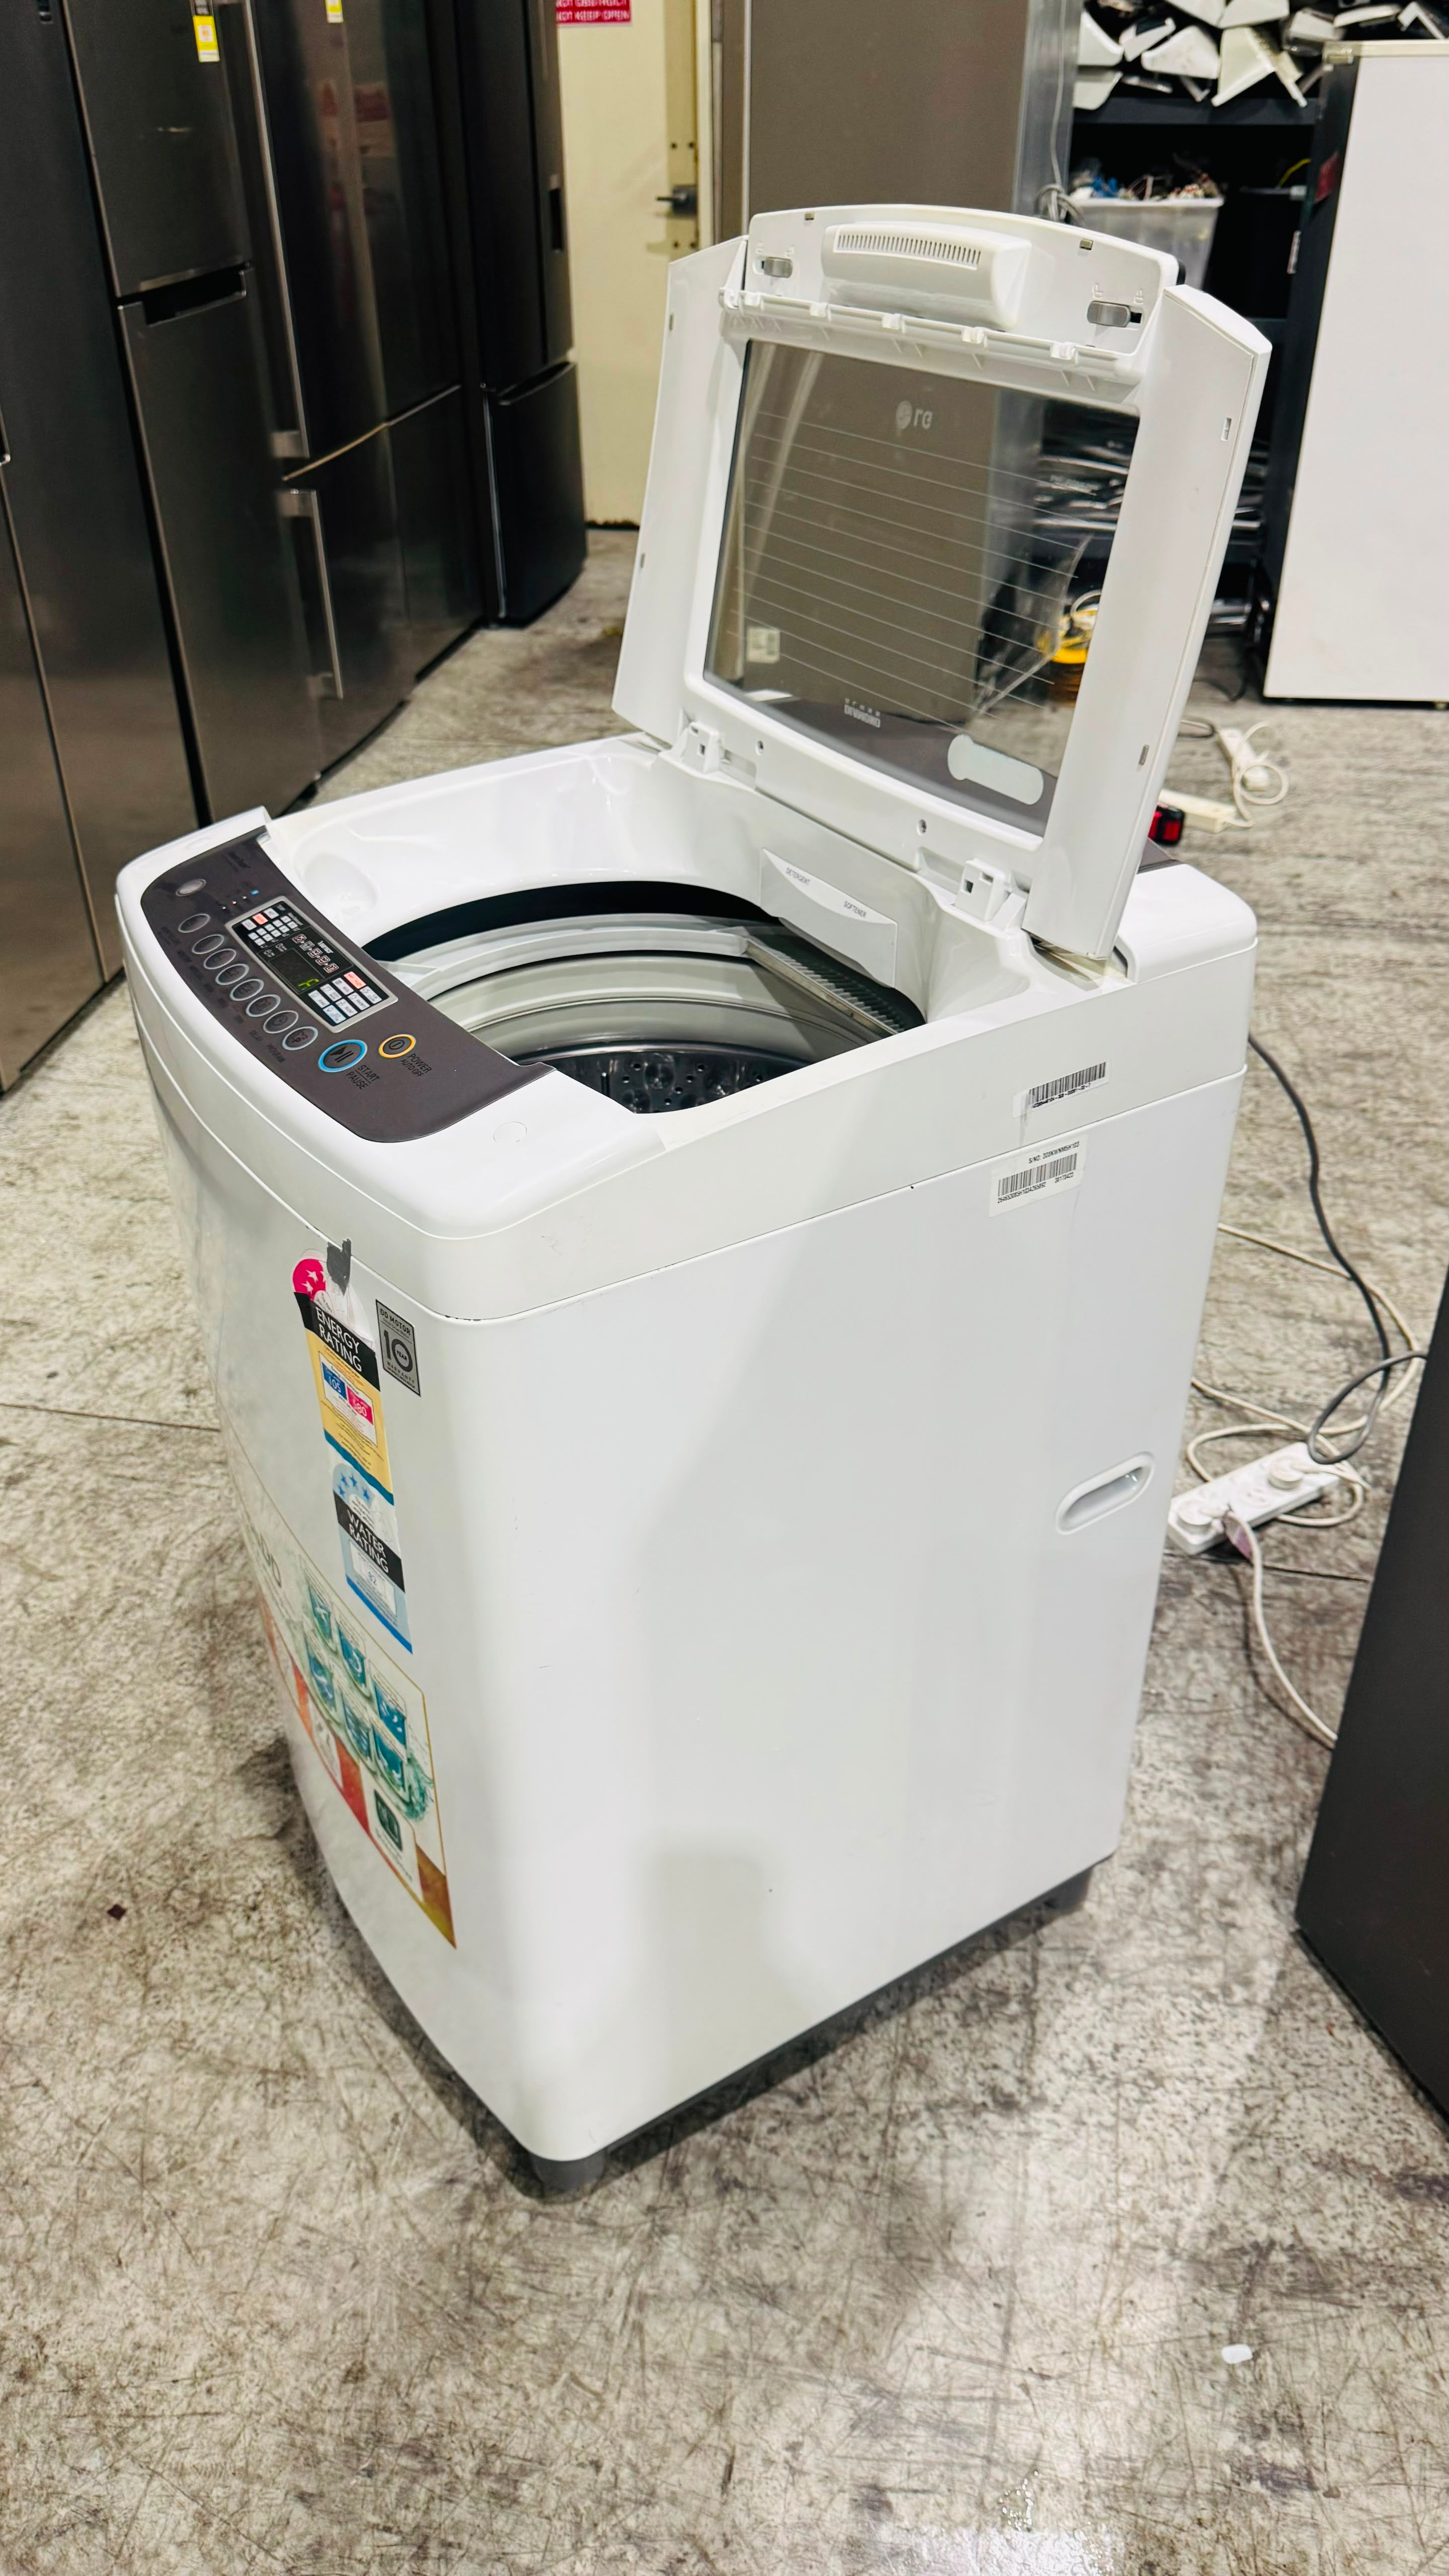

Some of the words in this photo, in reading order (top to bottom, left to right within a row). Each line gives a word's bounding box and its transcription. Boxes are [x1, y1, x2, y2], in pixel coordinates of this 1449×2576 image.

[575, 10, 601, 21] KEEP
[602, 10, 629, 21] OPEN
[786, 867, 810, 886] DETERGENT
[844, 901, 866, 918] SOFTENER
[408, 1053, 432, 1073] POWER
[346, 1071, 368, 1090] PAUSE
[357, 1065, 380, 1082] START
[315, 1307, 360, 1354] ENERGY
[380, 1308, 388, 1319] DD
[390, 1315, 411, 1336] MOTOR
[319, 1323, 362, 1372] RATING
[384, 1330, 413, 1373] 10
[396, 1349, 408, 1361] YEAR
[329, 1377, 342, 1393] 105
[347, 1510, 386, 1558] WATER
[348, 1523, 389, 1574] RATING
